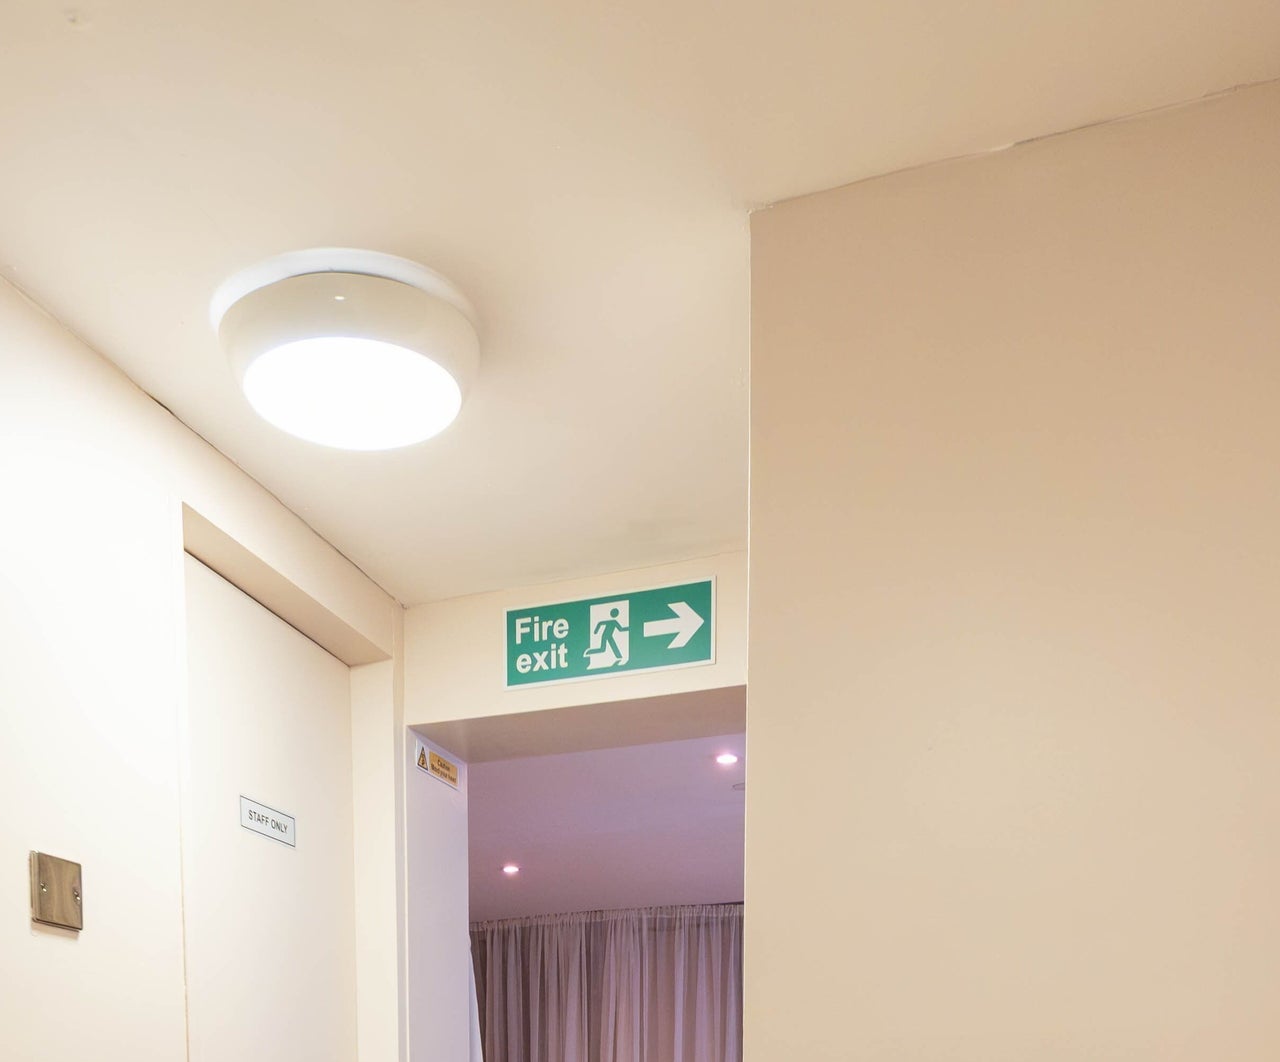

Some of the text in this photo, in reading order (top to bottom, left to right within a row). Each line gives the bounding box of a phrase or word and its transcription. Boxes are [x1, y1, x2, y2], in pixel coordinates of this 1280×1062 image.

[515, 616, 569, 645] Fire
[516, 643, 568, 674] exit
[248, 809, 288, 833] STAFF ONLY
